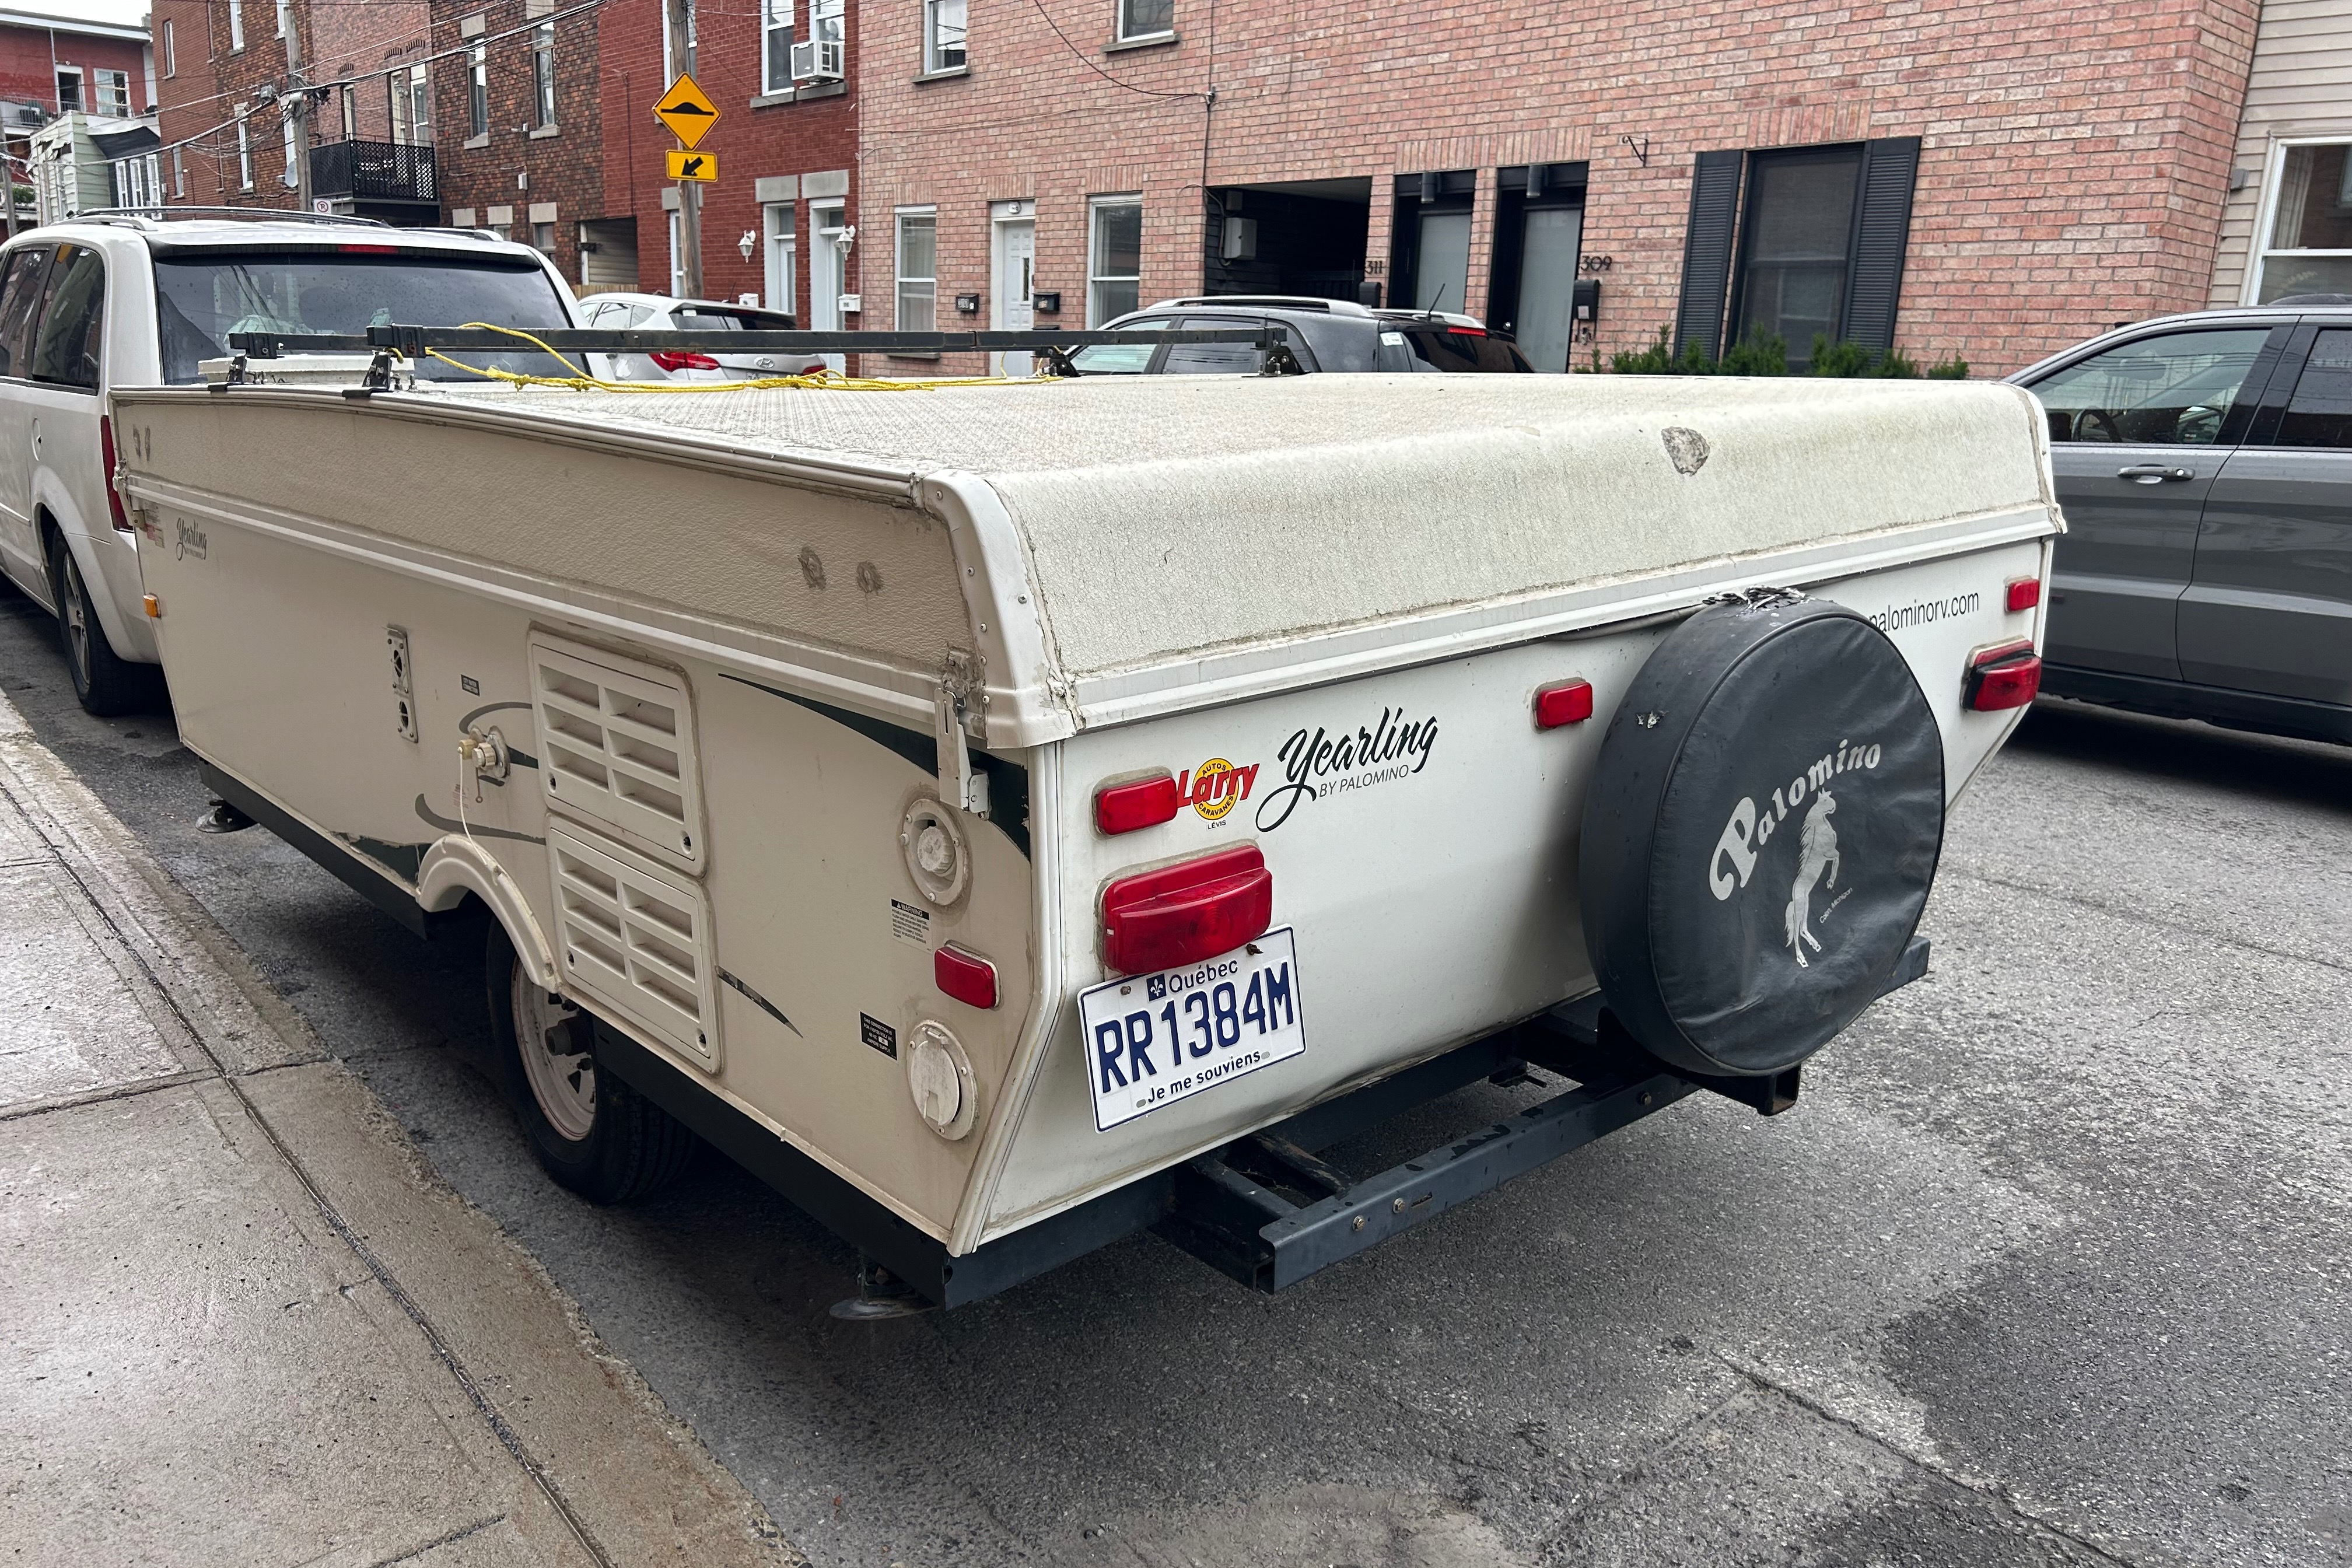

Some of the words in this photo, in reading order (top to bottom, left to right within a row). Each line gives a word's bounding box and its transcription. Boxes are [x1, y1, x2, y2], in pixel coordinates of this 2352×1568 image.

[1365, 260, 1382, 274] 311
[1580, 256, 1612, 271] 309
[176, 517, 207, 561] Yearling
[1177, 762, 1260, 808] Larry
[1202, 762, 1226, 776] AUTOS
[1255, 706, 1438, 832] Yearling
[1319, 780, 1337, 797] BY
[1339, 764, 1409, 793] PALOMINO
[1198, 795, 1234, 816] CARAVANES
[1709, 738, 1881, 901] Palomino
[1207, 820, 1226, 830] LÉVIS
[901, 903, 923, 917] WARNING
[1169, 959, 1238, 993] Québec
[1094, 961, 1294, 1094] RR1384M
[1147, 1087, 1165, 1102] Je
[1170, 1077, 1192, 1094] me
[1196, 1050, 1261, 1084] souviens
